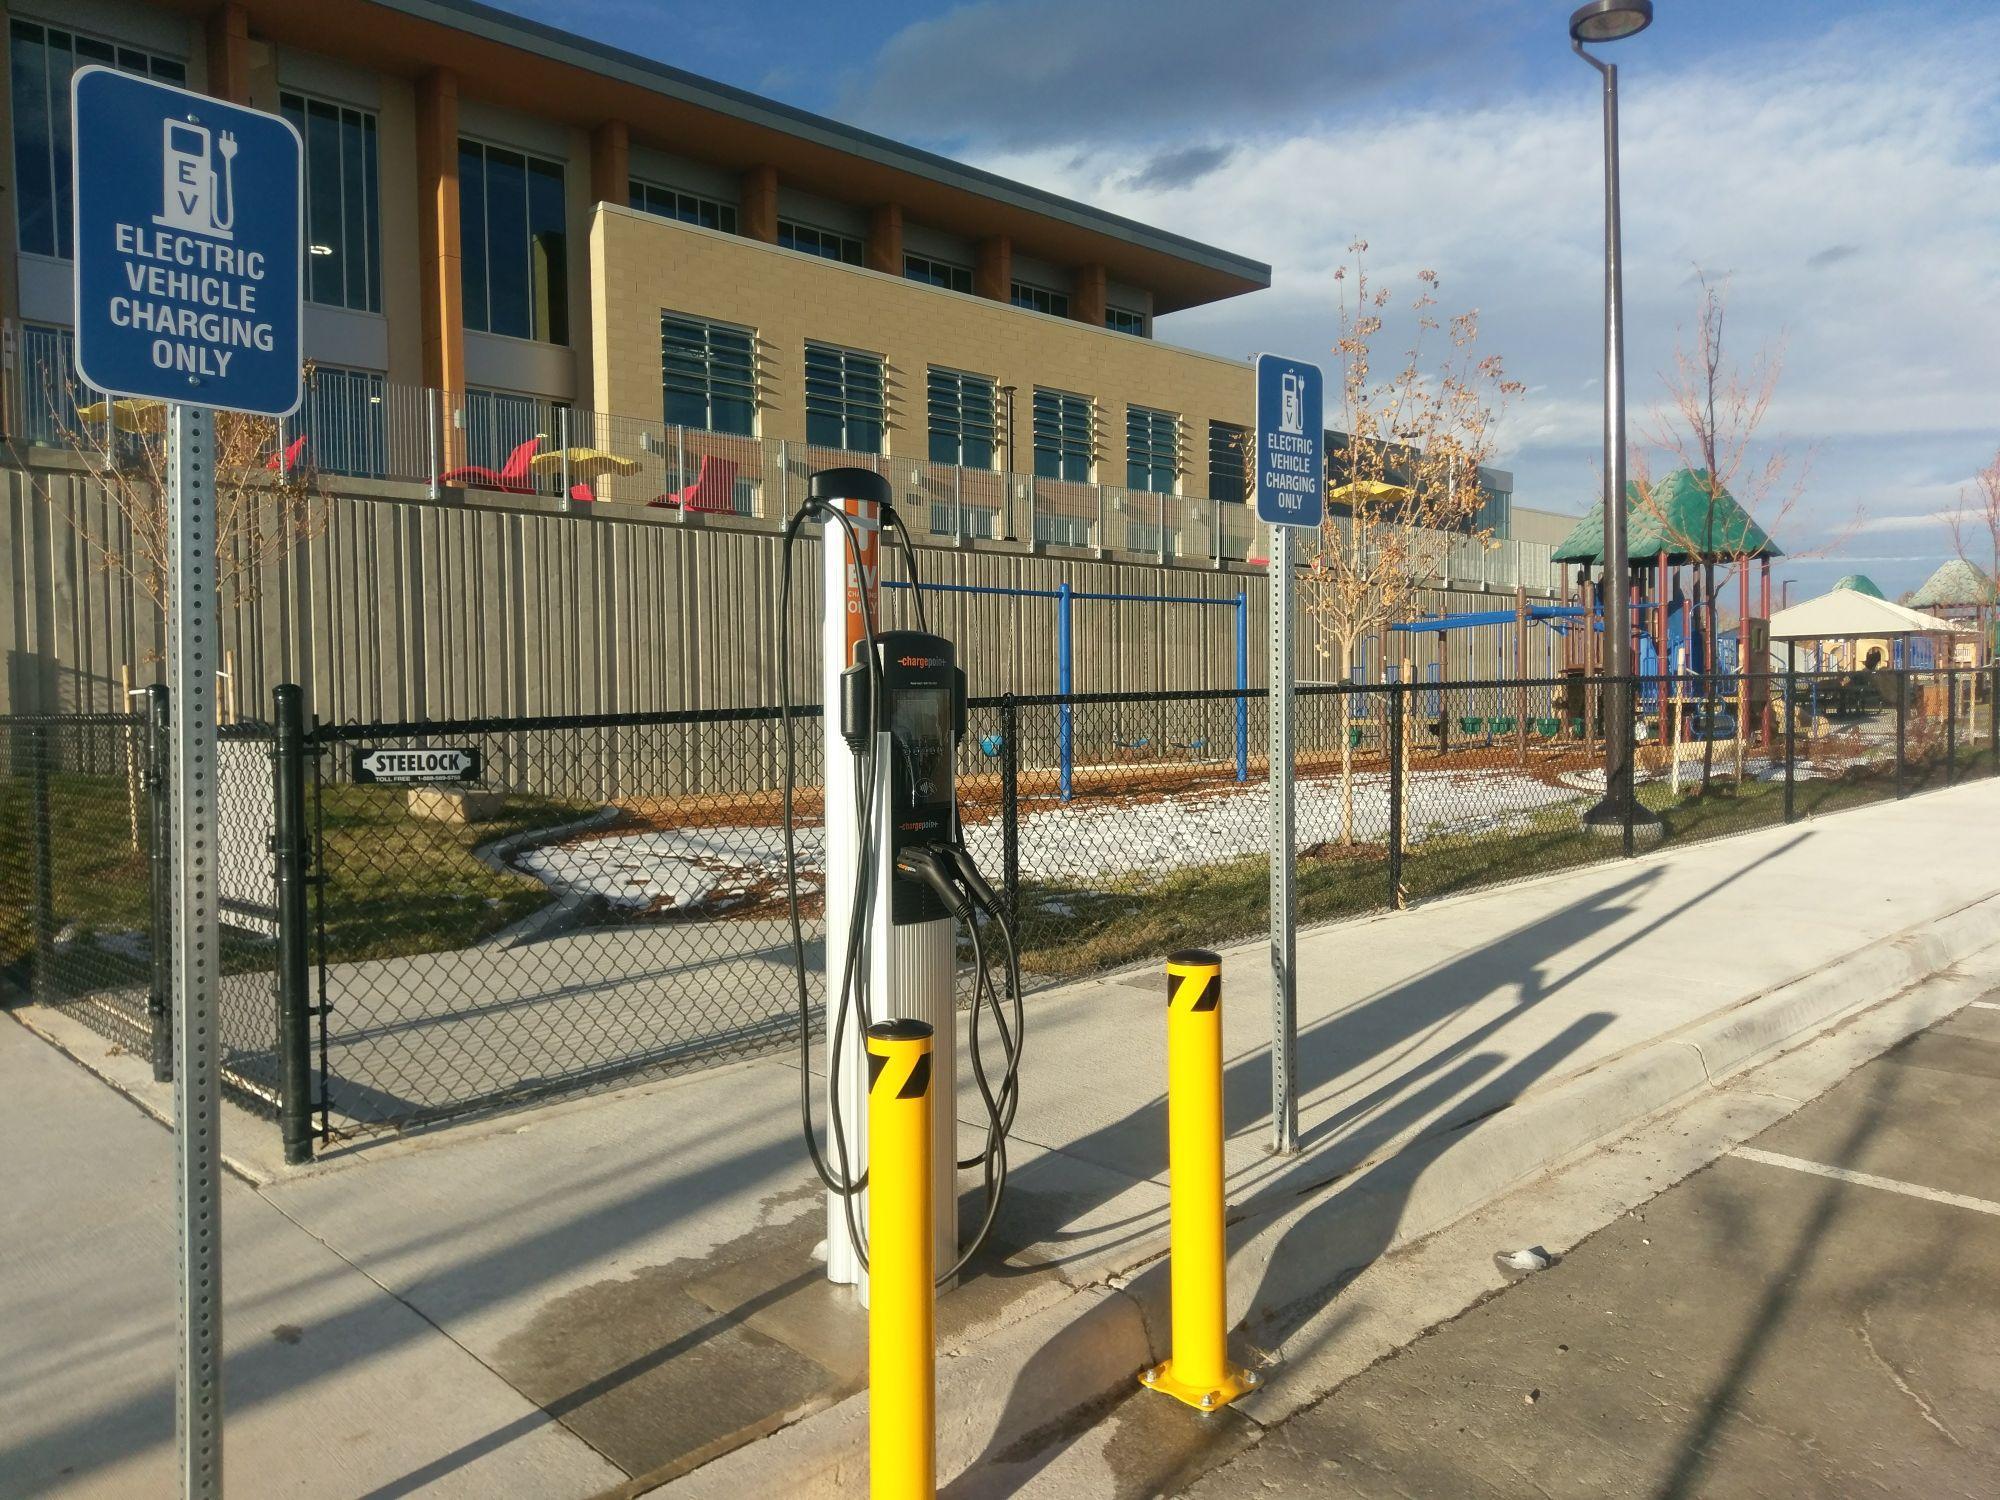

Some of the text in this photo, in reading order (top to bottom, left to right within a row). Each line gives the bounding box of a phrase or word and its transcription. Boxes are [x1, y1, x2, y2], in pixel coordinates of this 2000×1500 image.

[116, 223, 265, 280] ELECTRIC
[125, 262, 256, 313] VEHICLE
[110, 296, 274, 351] CHARGING
[153, 340, 232, 377] ONLY
[1268, 433, 1313, 454] ELECTRIC
[1271, 452, 1310, 473] VEHICLE
[1266, 472, 1315, 493] CHARGING
[1278, 492, 1303, 509] ONLY
[848, 601, 877, 614] OY
[376, 754, 460, 772] STEELOCK
